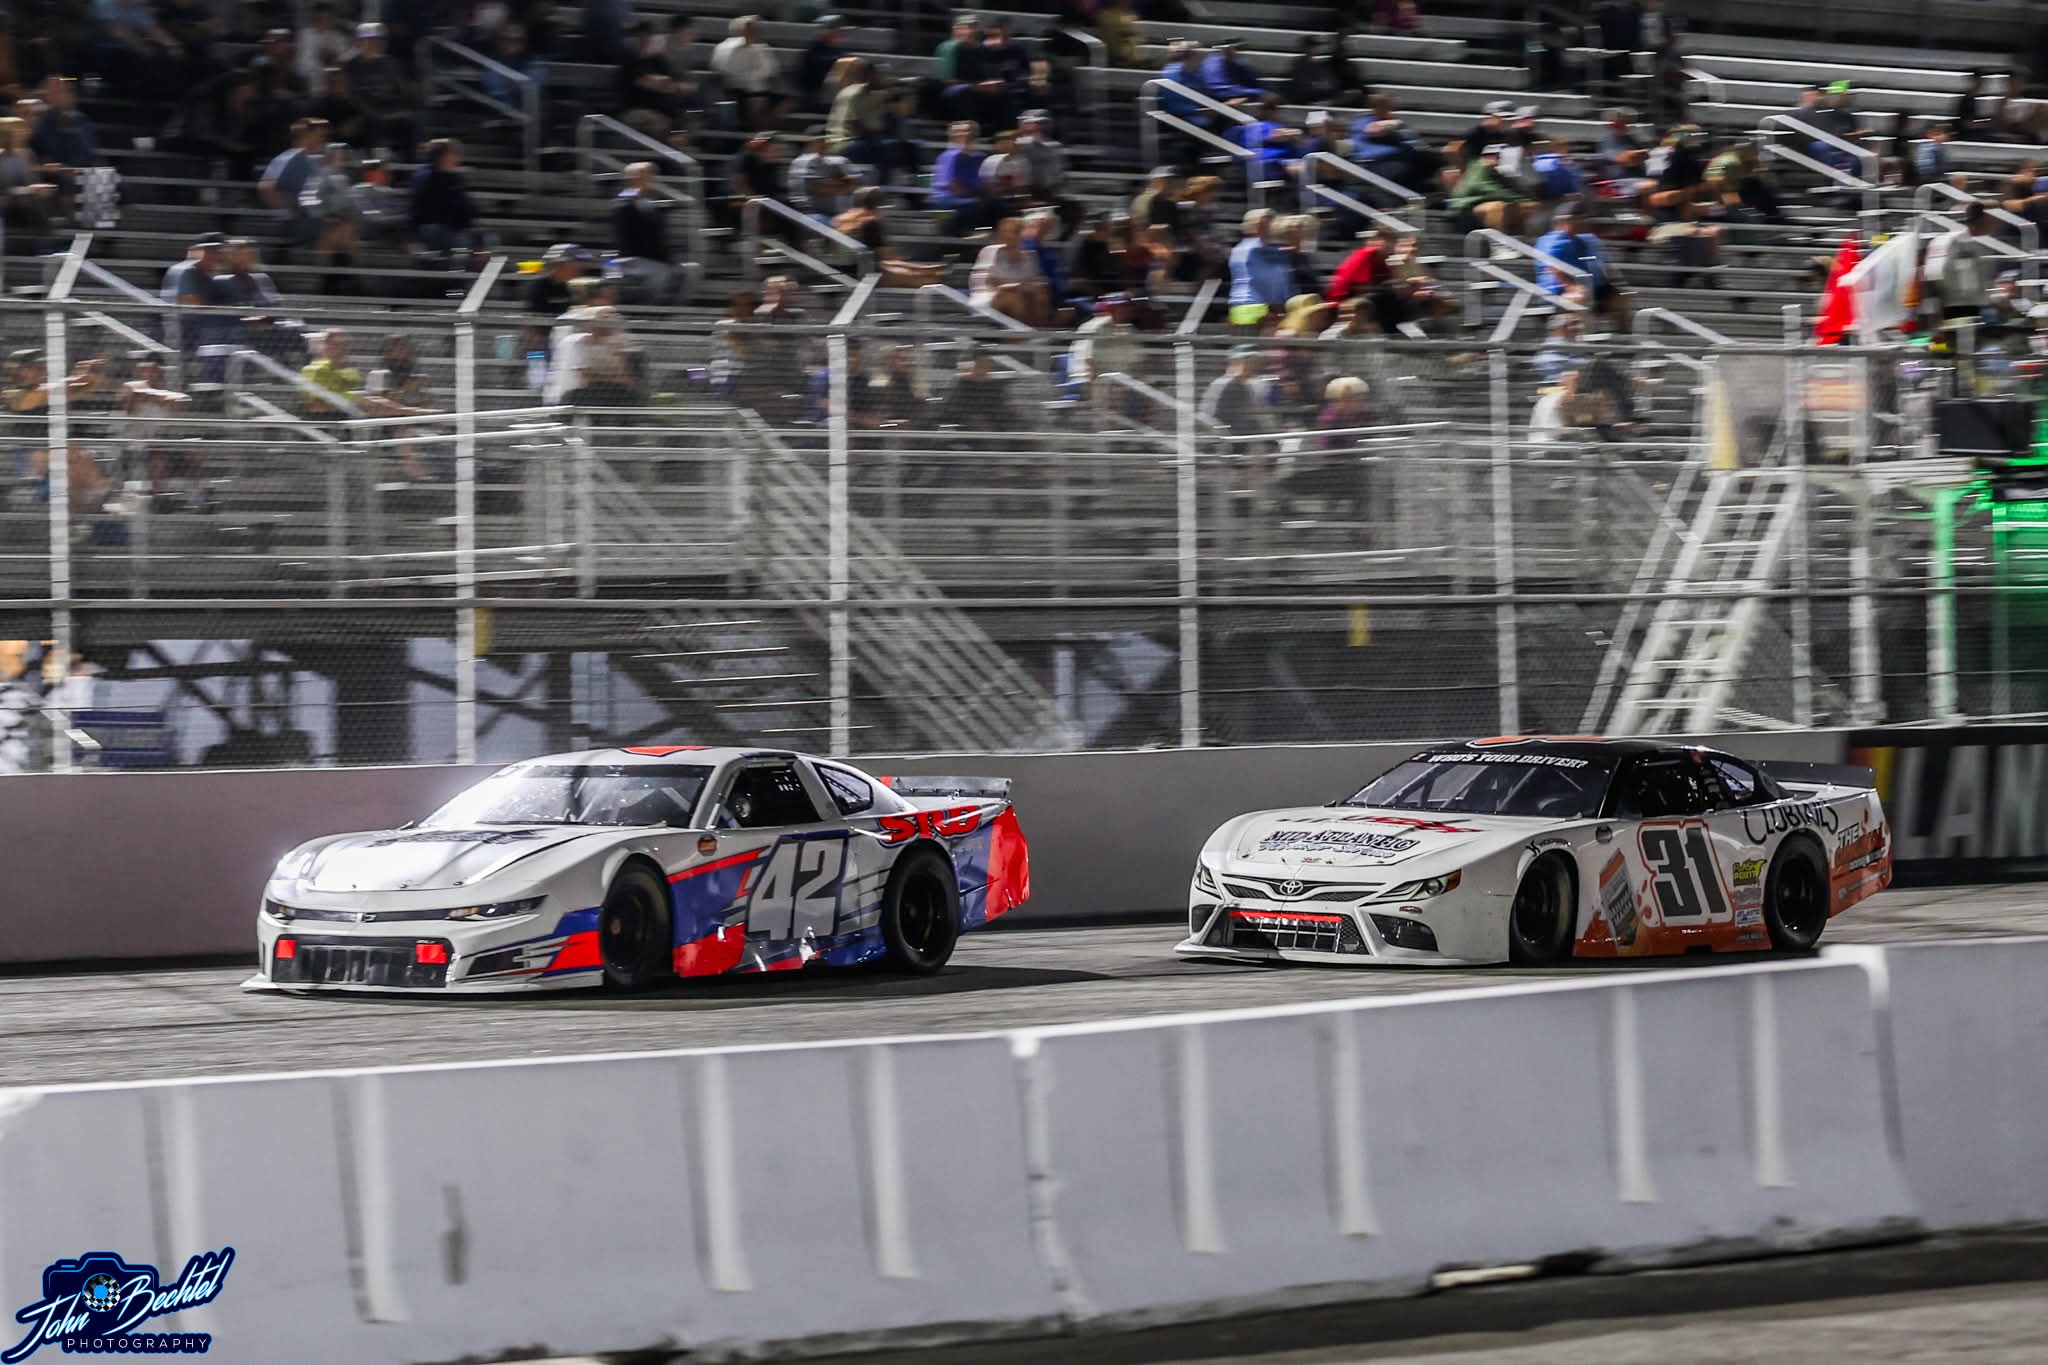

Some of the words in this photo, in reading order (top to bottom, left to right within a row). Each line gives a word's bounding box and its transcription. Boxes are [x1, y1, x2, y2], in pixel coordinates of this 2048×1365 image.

[1427, 753, 1478, 763] WHO'S
[1475, 754, 1518, 763] YOUR
[1516, 755, 1589, 769] DRIVER?
[1305, 830, 1421, 852] ATLANTIC
[747, 837, 844, 941] 42
[1640, 825, 1730, 919] 31
